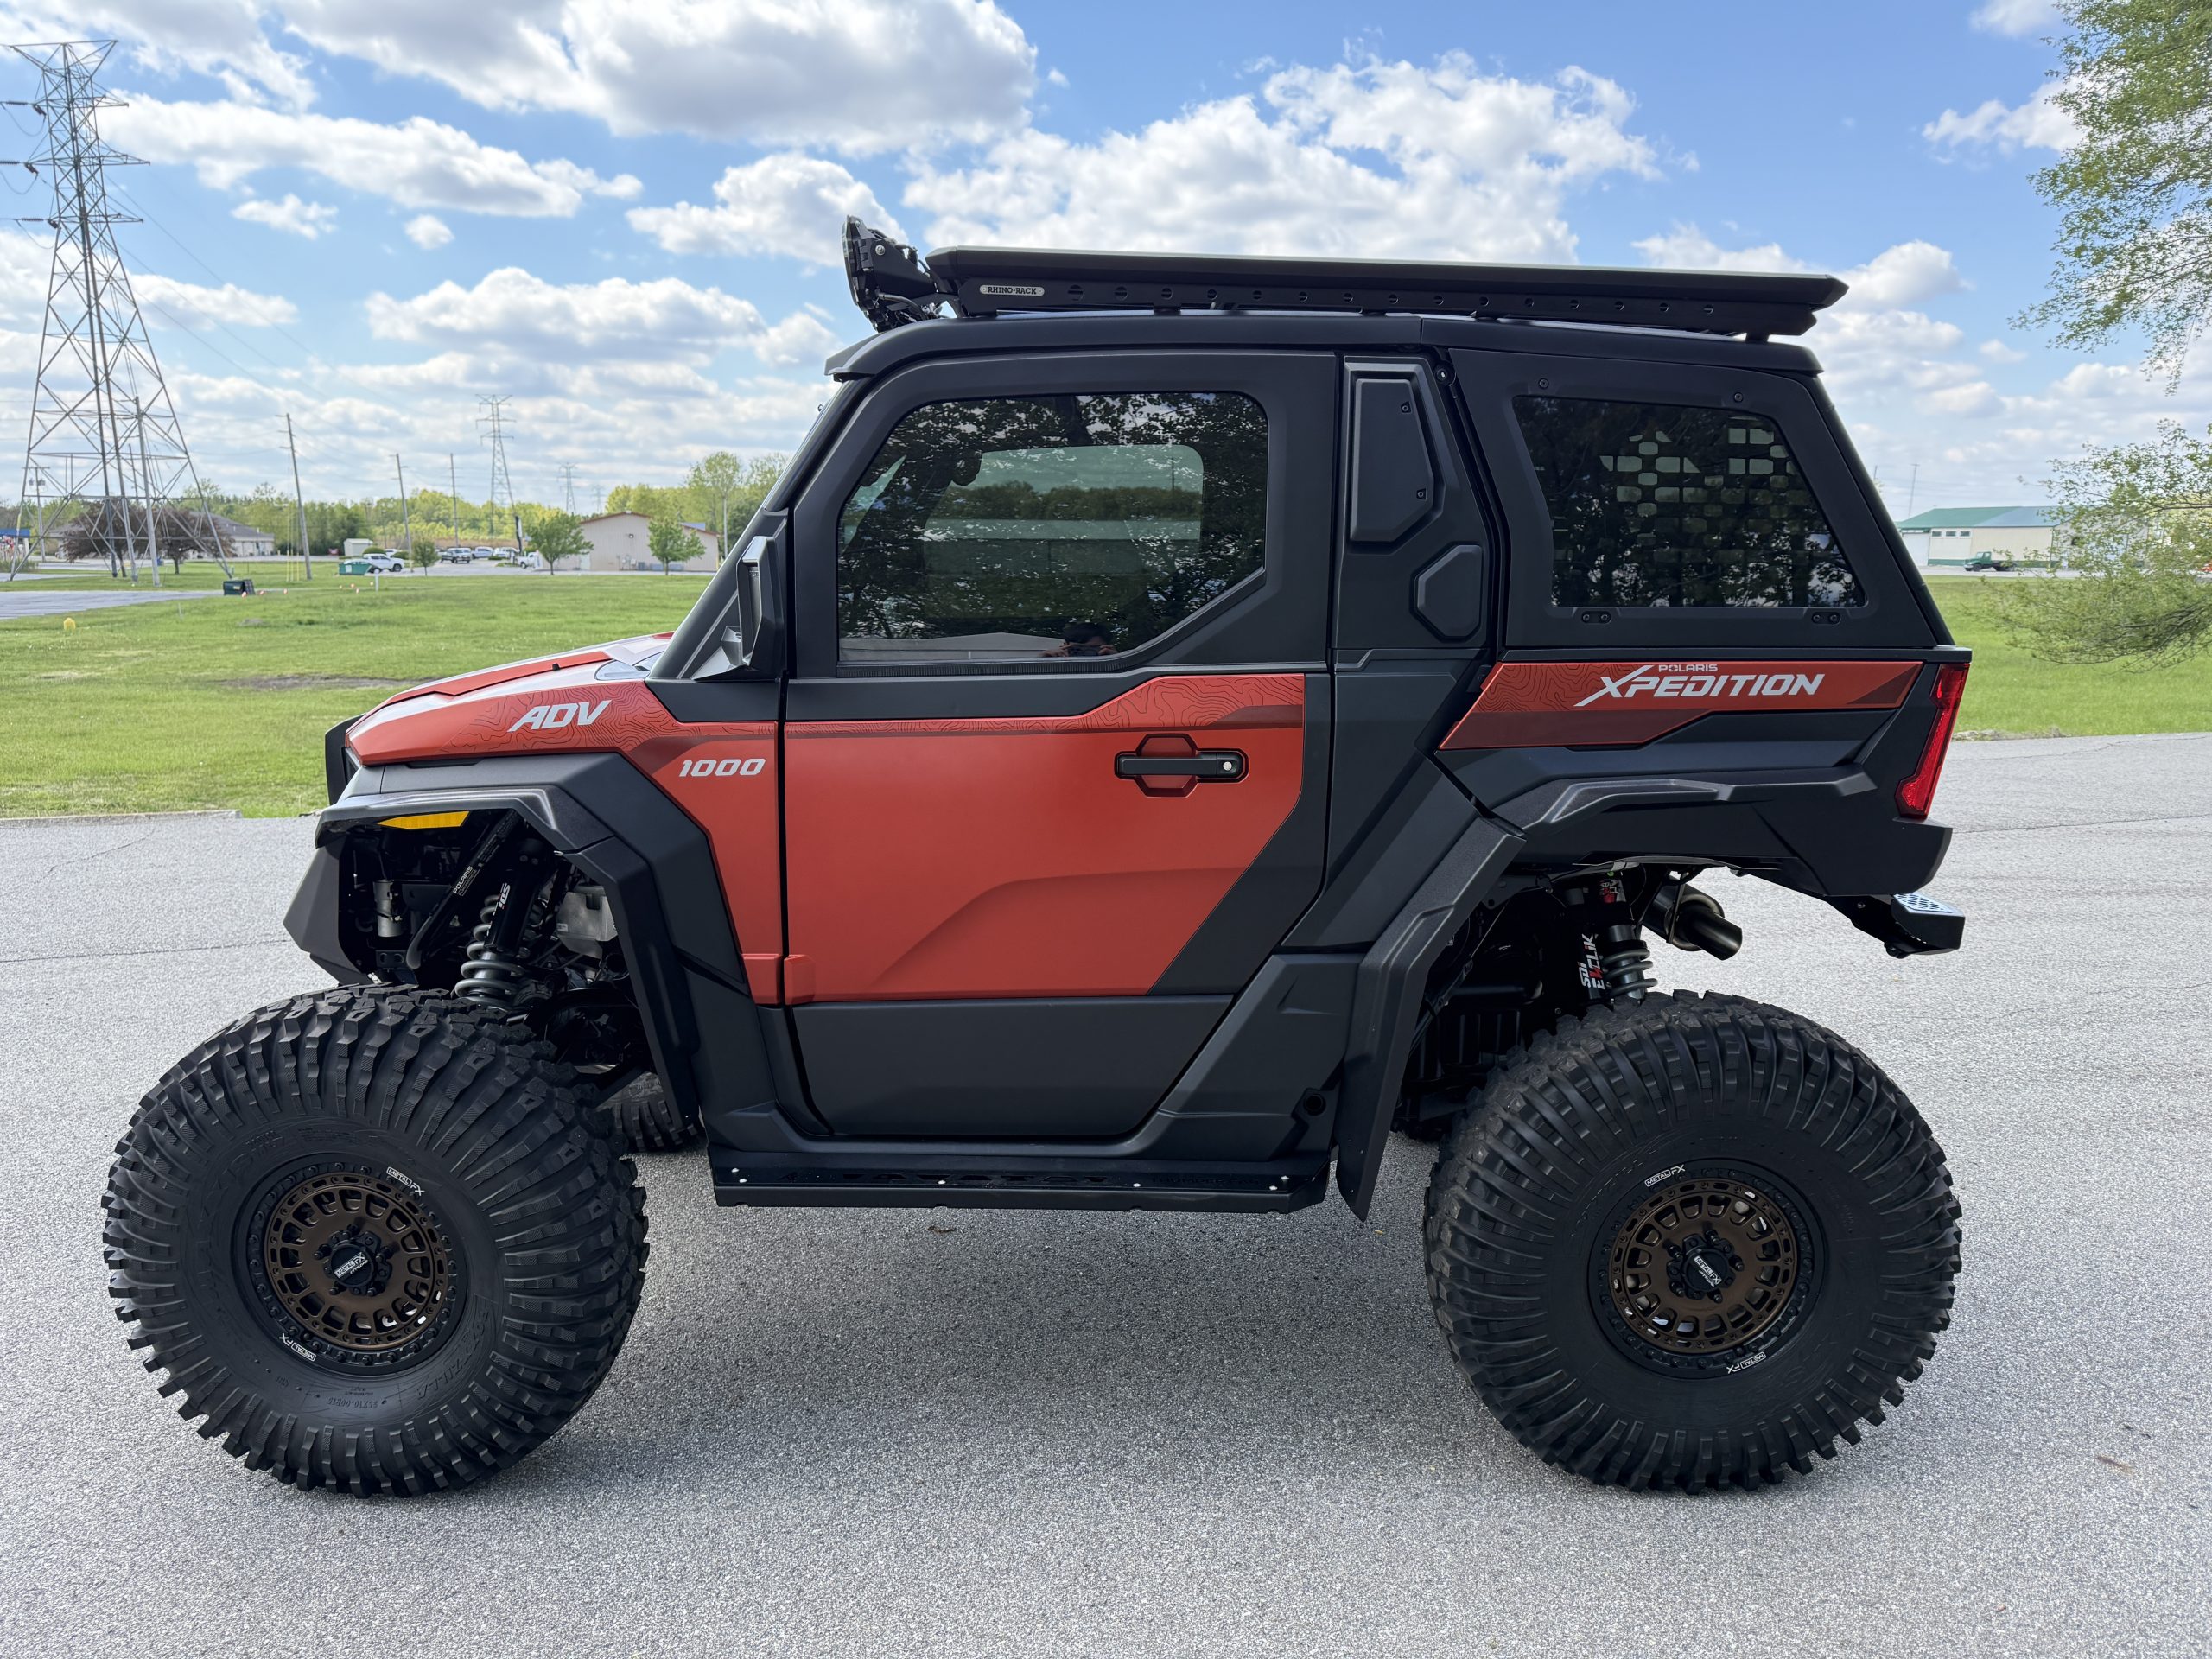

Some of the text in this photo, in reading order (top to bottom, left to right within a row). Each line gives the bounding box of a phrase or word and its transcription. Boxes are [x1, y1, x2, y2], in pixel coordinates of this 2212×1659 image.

[988, 286, 1037, 295] RHINO-RACK
[1658, 664, 1718, 672] POLARIS
[1573, 664, 1825, 707] XPEDITION
[507, 700, 612, 732] ADV
[679, 758, 766, 777] 1000
[453, 866, 474, 894] POLARIS
[387, 1166, 425, 1196] METAL FX
[1644, 1164, 1686, 1187] METAL FX
[278, 1333, 316, 1362] METAL FX
[1726, 1352, 1766, 1374] METAL FX
